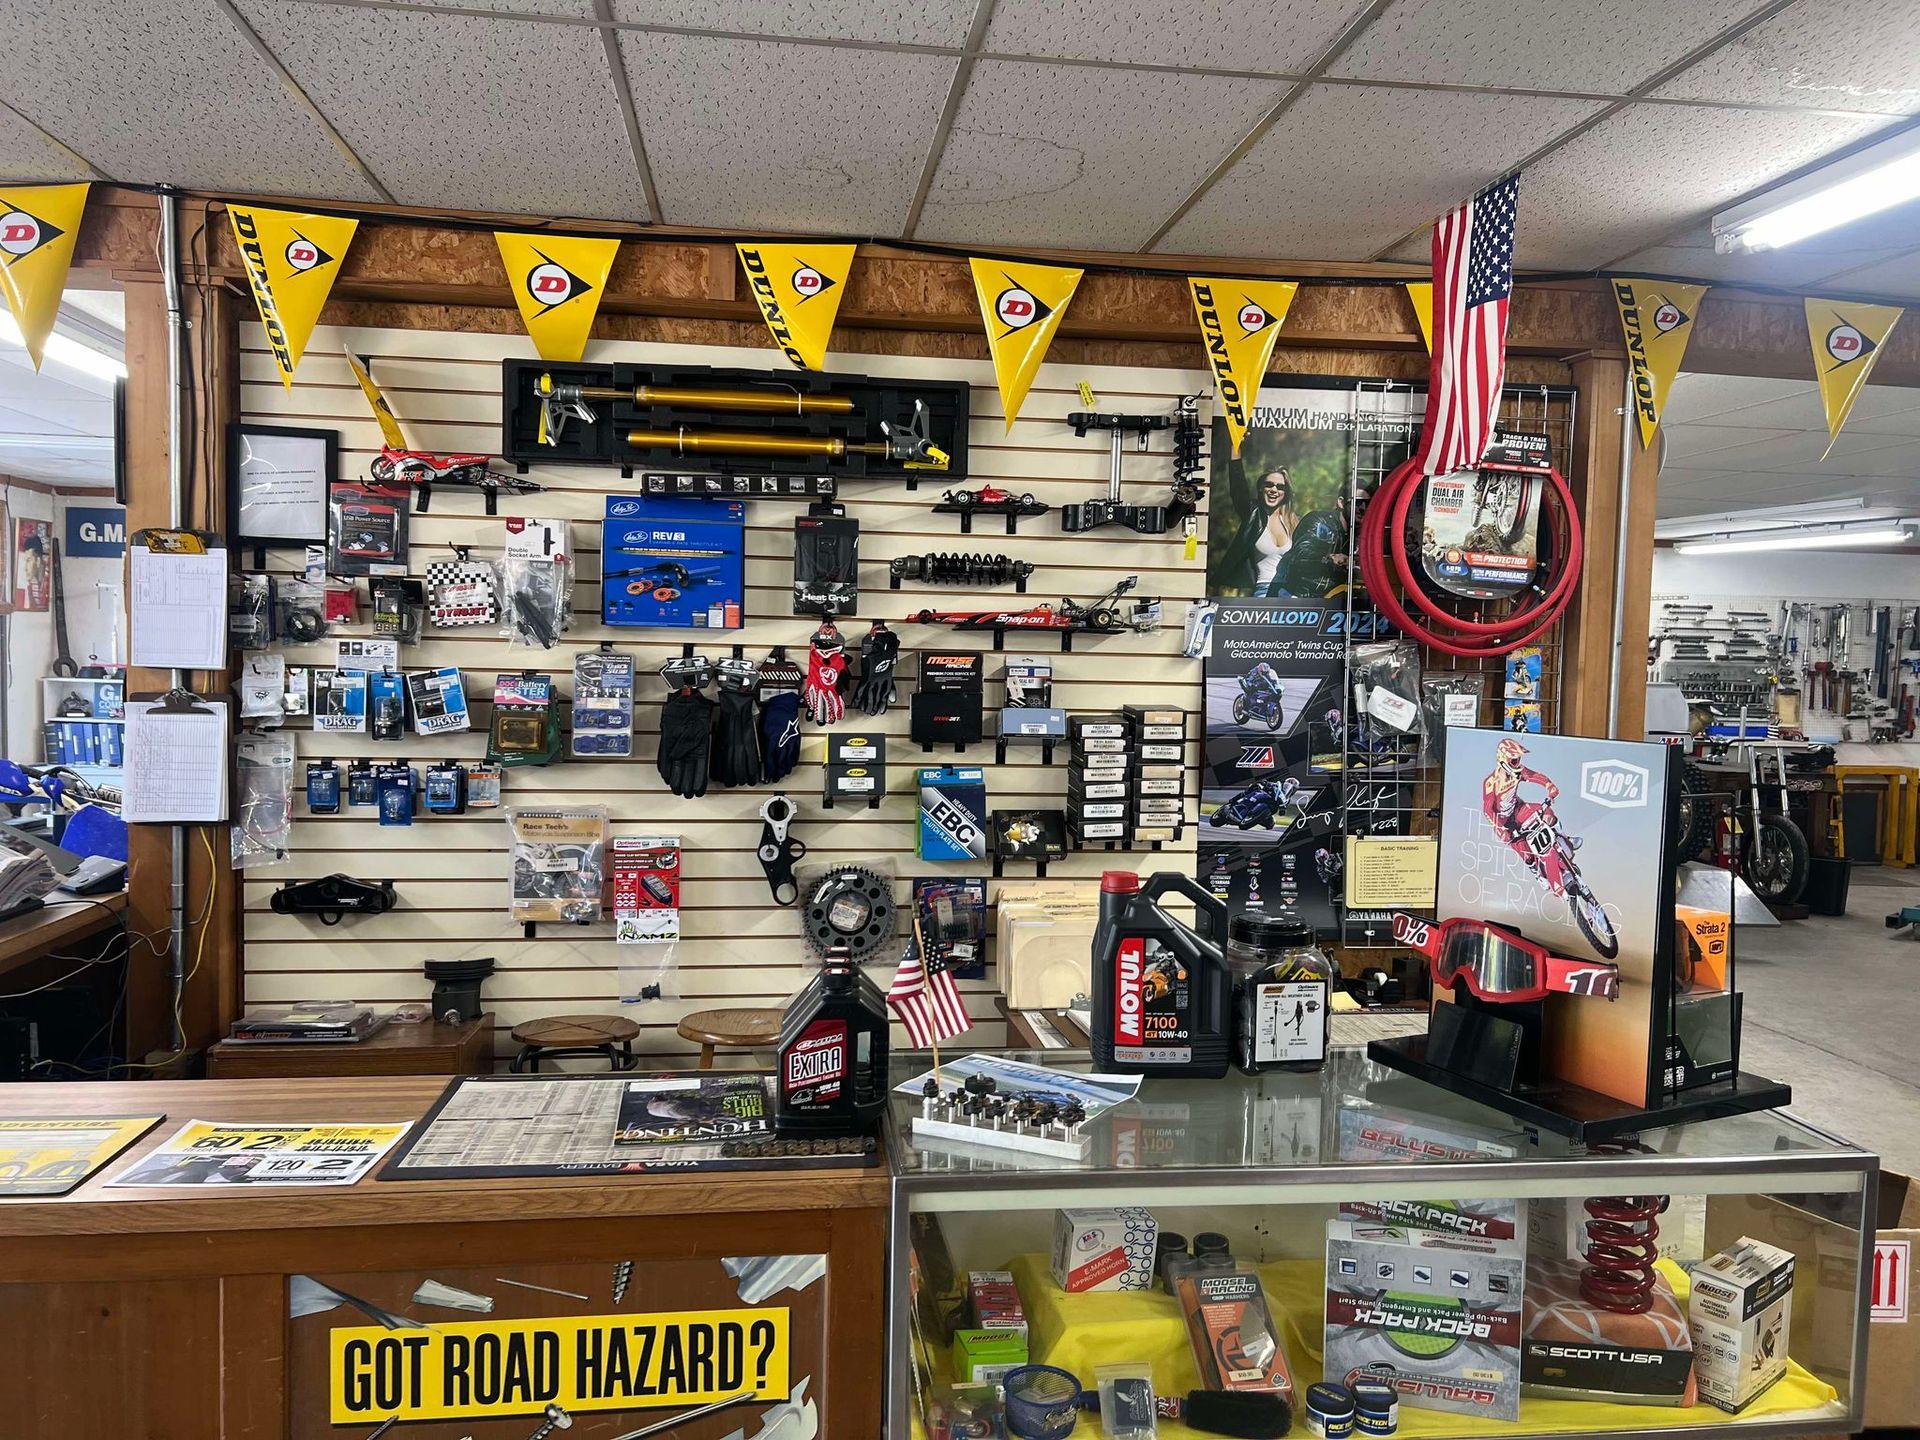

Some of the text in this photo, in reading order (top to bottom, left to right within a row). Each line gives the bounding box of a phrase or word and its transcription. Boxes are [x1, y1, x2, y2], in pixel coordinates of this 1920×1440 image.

[1, 224, 36, 242] D
[291, 248, 315, 262] D
[538, 276, 568, 292] D
[798, 276, 818, 288] D
[232, 210, 292, 373] DUNLOP
[1002, 300, 1032, 317] D
[1243, 312, 1264, 324] D
[1658, 311, 1680, 325] D
[1832, 336, 1859, 350] D
[1194, 283, 1244, 426] DUNLOP
[1615, 284, 1657, 423] DUNLOP
[1252, 418, 1332, 430] MAXIMUM
[1502, 440, 1546, 450] PROVEN!
[1432, 488, 1464, 498] DUAL AIR
[1431, 498, 1463, 508] CHAMBER
[1484, 556, 1528, 565] PROTECTION
[1484, 570, 1528, 579] PERFORMANCE
[802, 593, 849, 602] Heat Grip
[996, 614, 1045, 625] Snap-on
[1327, 613, 1389, 633] 2024
[1323, 642, 1344, 650] Cup
[1231, 650, 1334, 660] Giaccomoto Yamaha
[518, 680, 548, 689] Battery
[496, 688, 545, 696] TESTER
[324, 718, 357, 726] DRAG
[428, 715, 460, 727] DRAG
[1590, 771, 1639, 799] 100%
[952, 799, 977, 822] HEAVY DUTY
[931, 801, 975, 843] EBC
[924, 818, 961, 852] CLUTCH PLATE SET
[1531, 828, 1549, 853] 10
[1459, 873, 1496, 905] OF
[1503, 880, 1622, 936] RACING
[1696, 922, 1725, 935] Strata 2
[1121, 950, 1140, 1036] MOTUL
[1145, 1016, 1177, 1029] 7100
[1158, 1031, 1188, 1039] 10W-40
[789, 1047, 842, 1082] EXTRA
[736, 1104, 763, 1118] BIG
[644, 1160, 699, 1168] YUASA
[1351, 1203, 1427, 1229] Back-Up Power Pack and
[1427, 1212, 1487, 1235] PACK
[1084, 1255, 1113, 1275] E-MARK
[1072, 1257, 1126, 1289] APPROVED HORN
[1202, 1278, 1247, 1287] MOOSE
[1211, 1284, 1256, 1295] RACING
[1699, 1282, 1735, 1298] MOOSE
[1338, 1298, 1356, 1306] Start
[1431, 1308, 1446, 1317] Pack
[1446, 1311, 1475, 1320] Power
[1476, 1313, 1507, 1323] Back-Up
[1354, 1309, 1491, 1338] BACK PACK
[1548, 1348, 1663, 1365] SCOTT USA
[344, 1319, 776, 1411] GOT ROAD HAZARD?
